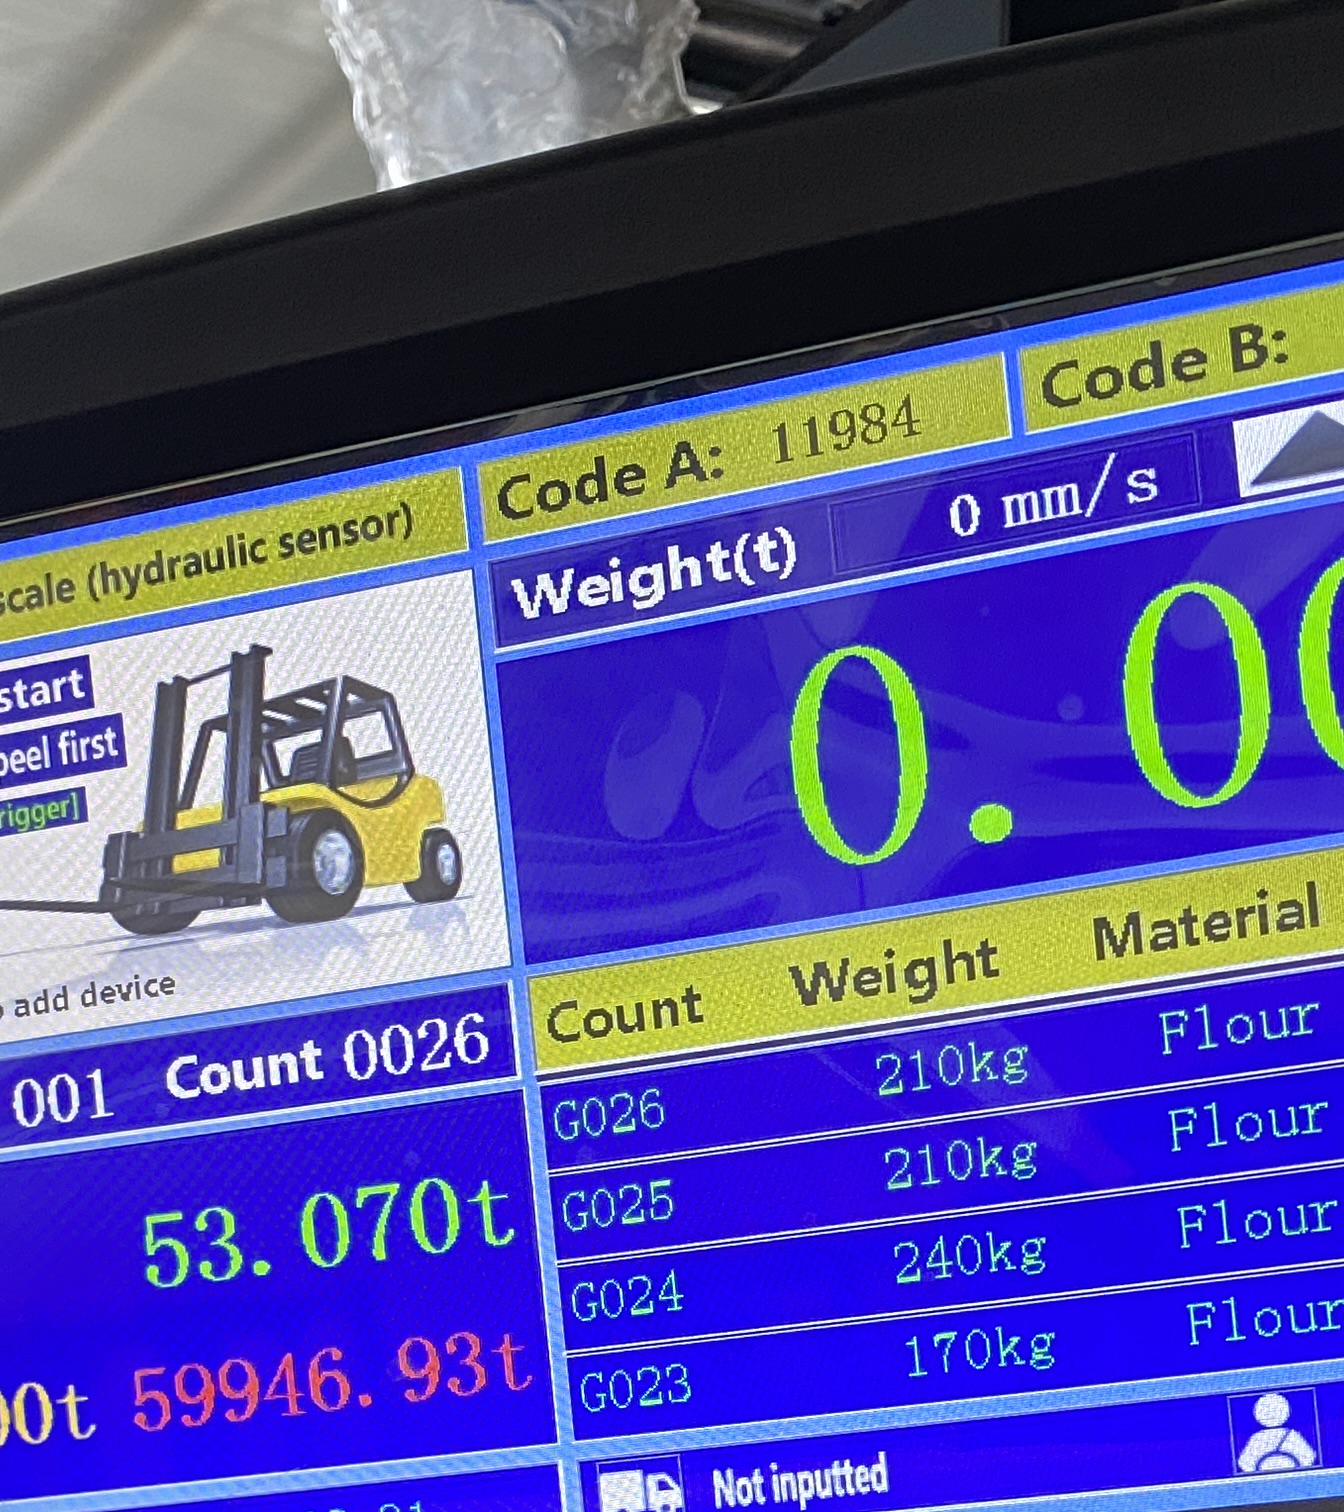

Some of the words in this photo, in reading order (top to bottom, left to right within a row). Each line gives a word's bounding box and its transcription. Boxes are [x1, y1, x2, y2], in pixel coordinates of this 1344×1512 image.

[1040, 335, 1208, 410] Code
[1227, 321, 1290, 374] B:
[770, 394, 923, 466] 11984
[497, 450, 646, 521] Code
[654, 440, 724, 498] A:
[947, 491, 981, 540] 0
[1003, 451, 1160, 532] mm/s
[88, 532, 266, 602] (hydraulic
[279, 501, 414, 558] sensor)
[511, 525, 799, 622] Weight(t)
[58, 726, 119, 766] first
[14, 985, 70, 1018] add
[80, 972, 176, 1010] device
[546, 982, 704, 1047] Count
[786, 938, 1001, 1008] Weight
[1092, 880, 1320, 964] Material
[12, 1069, 115, 1128] 001
[166, 1038, 324, 1101] Count
[343, 1012, 490, 1081] 0026
[873, 1040, 1031, 1097] 210kg
[1157, 997, 1320, 1055] Flour
[882, 1134, 1039, 1192] 210kg
[1167, 1093, 1330, 1152] Flour
[142, 1177, 516, 1289] 53.070t
[892, 1228, 1048, 1287] 240kg
[1176, 1194, 1339, 1249] Flour
[132, 1330, 534, 1433] 59946.93t
[903, 1323, 1058, 1379] 170kg
[711, 1464, 763, 1509] Not
[770, 1453, 889, 1511] inputted
